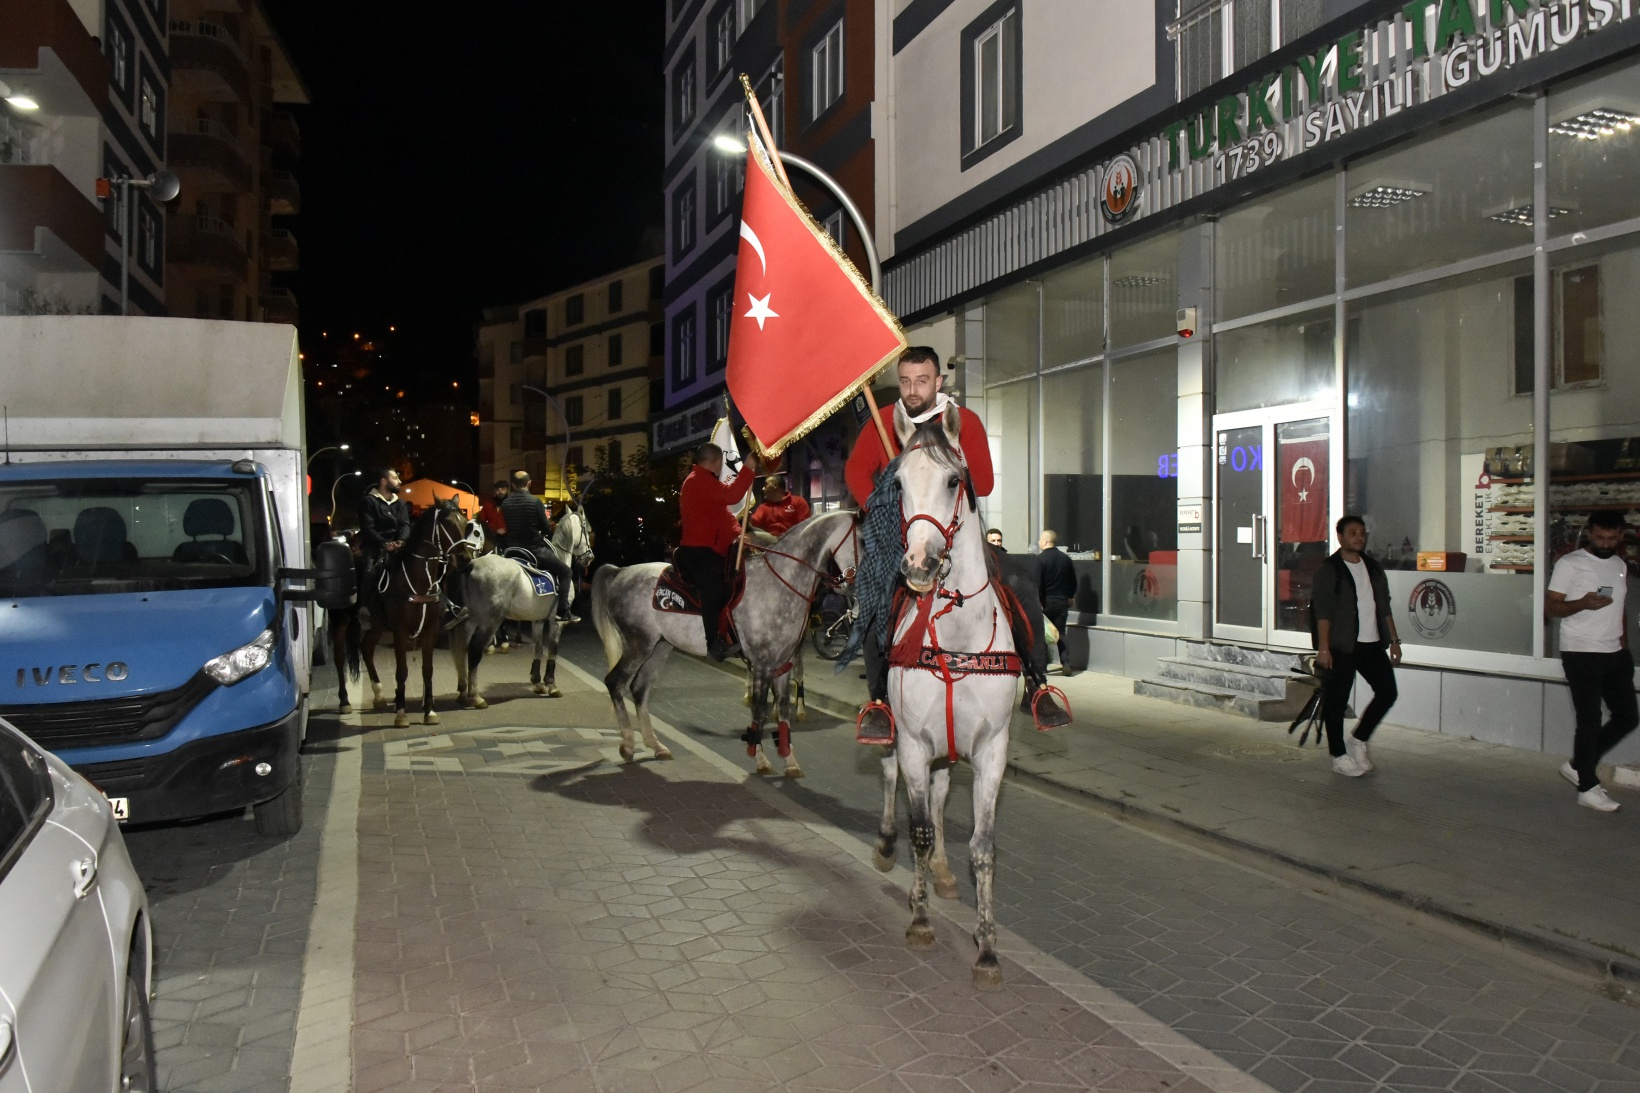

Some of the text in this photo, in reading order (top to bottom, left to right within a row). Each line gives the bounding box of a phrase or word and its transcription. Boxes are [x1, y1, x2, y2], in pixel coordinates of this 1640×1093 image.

[1216, 0, 1640, 185] 1739 SAYILI GÜMÜŞ
[1474, 492, 1484, 554] BEREKET
[16, 661, 129, 687] IVECO
